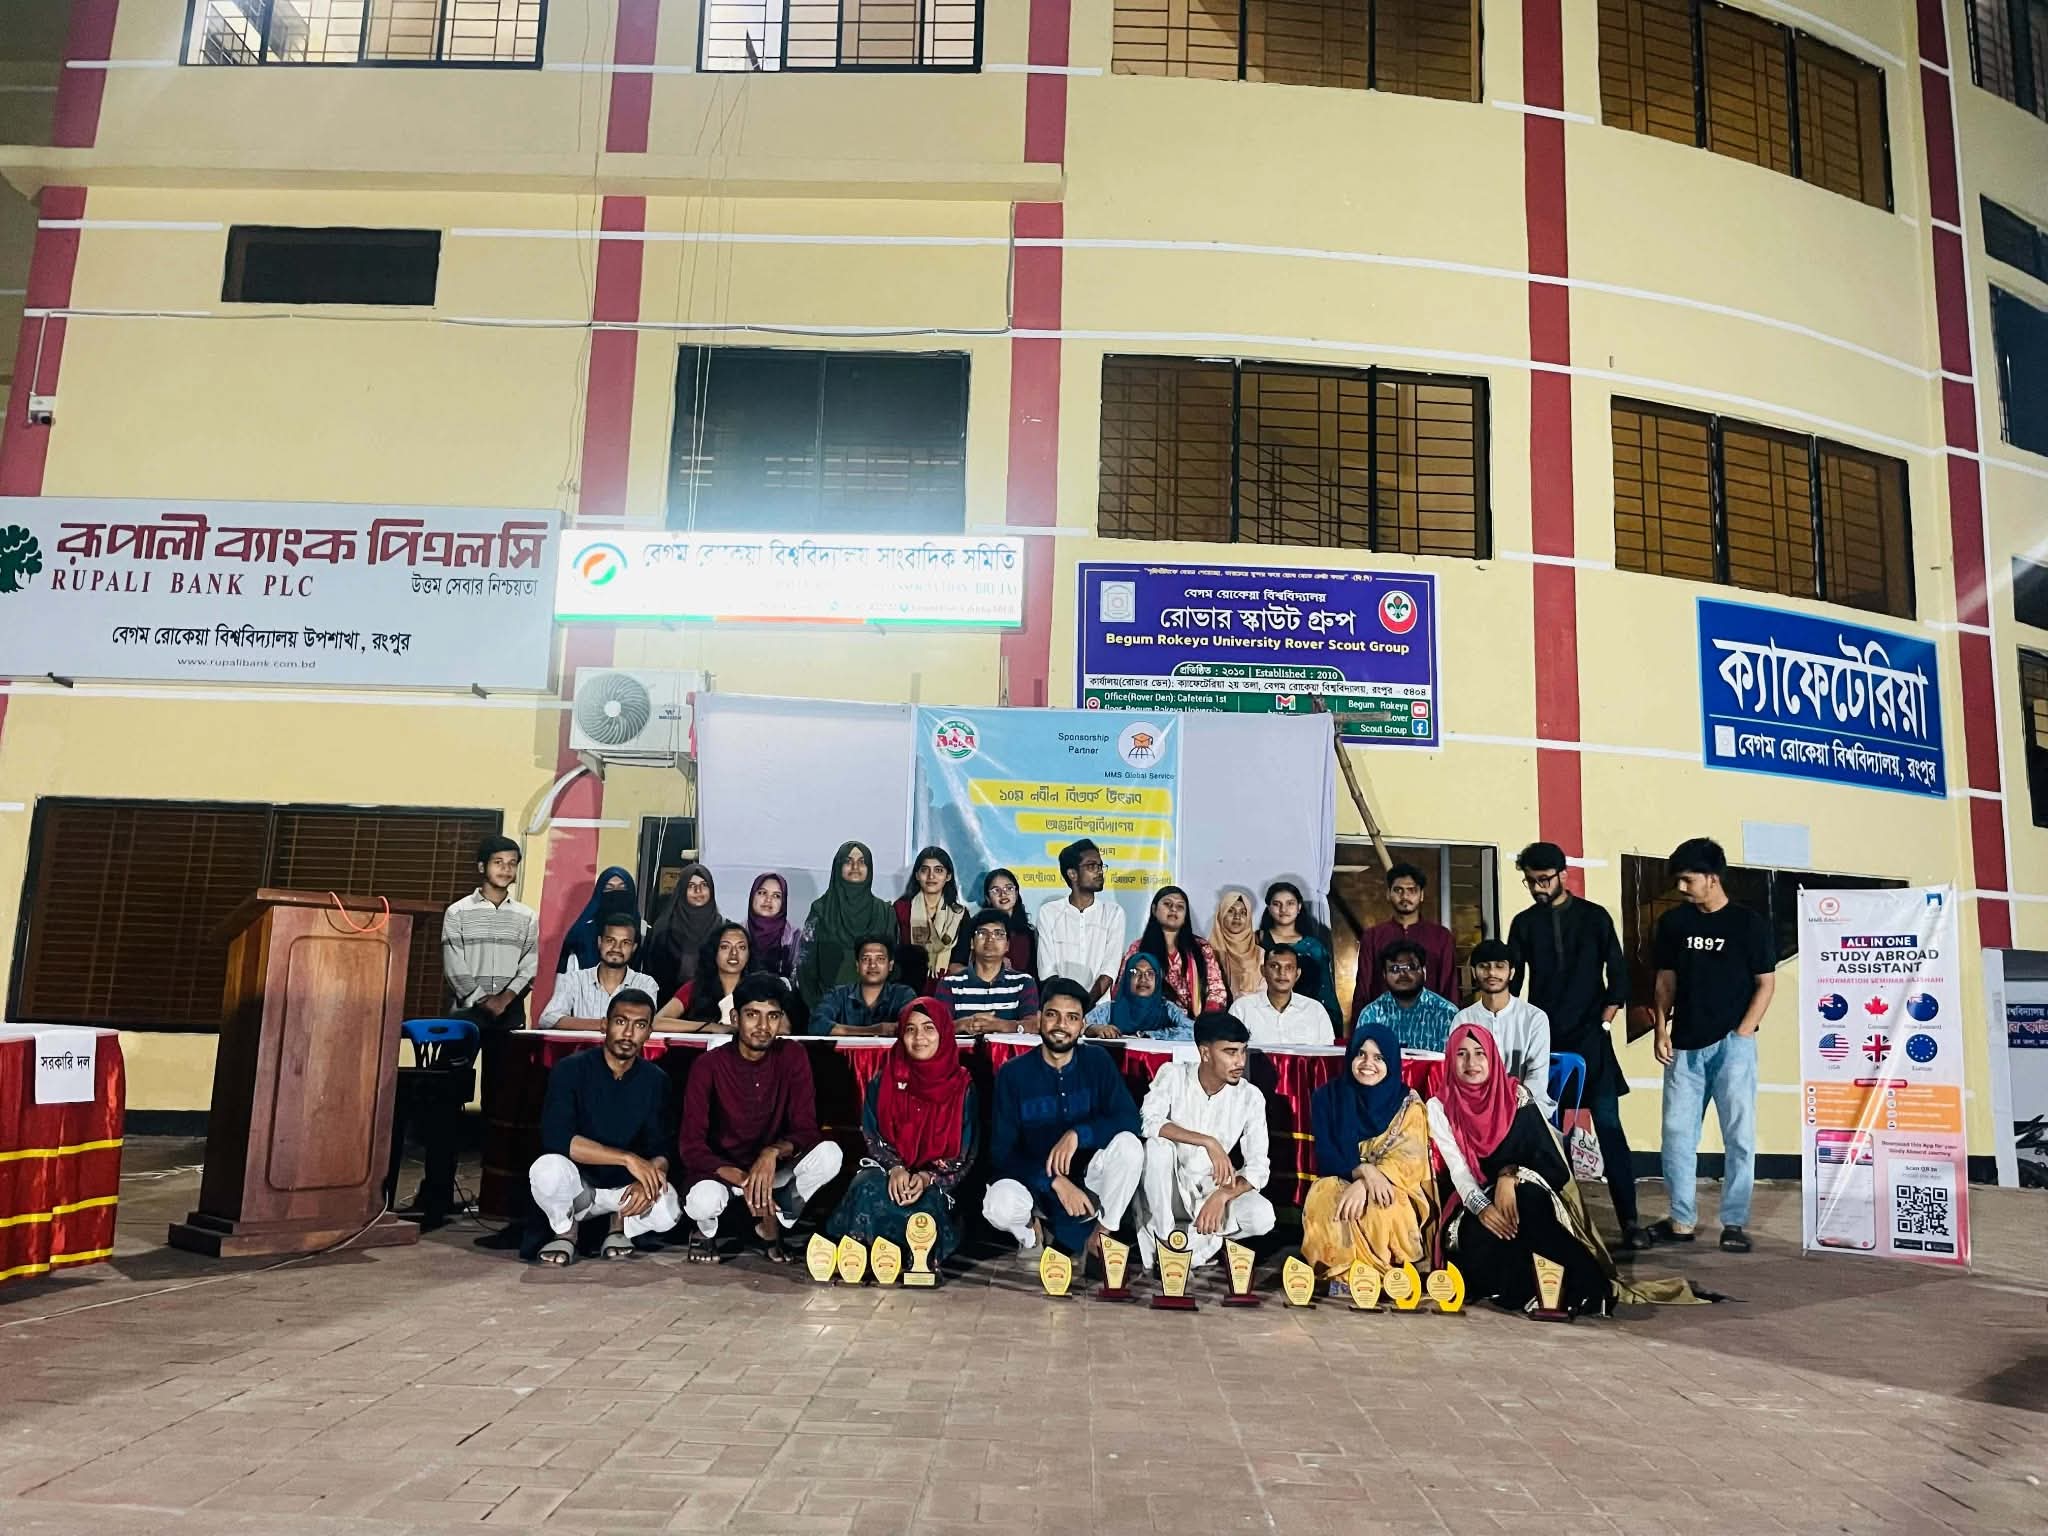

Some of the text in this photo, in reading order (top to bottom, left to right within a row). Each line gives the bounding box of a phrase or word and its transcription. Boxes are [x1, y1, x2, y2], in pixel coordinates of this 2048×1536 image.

[57, 513, 548, 569] রূপালী ব্যাংক পিএলসি
[962, 544, 1017, 570] সমিতি
[51, 569, 314, 597] RUPALI BANK PLC
[411, 571, 539, 597] উত্তম সেবার নিশ্চয়তা
[1184, 589, 1326, 603] বেগম রোকেয়া বিশ্ববিদ্যালয়
[1160, 603, 1357, 636] রোভার স্কাউট গ্রুপ
[113, 623, 411, 656] বেগম রোকেয়া বিশ্ববিদ্যালয় উপশাখা, রংপুর
[1105, 633, 1410, 655] Begum Rokeya University Rover Scout Group
[1255, 669, 1306, 679] Established
[1317, 671, 1338, 680] 2010
[1711, 633, 1929, 741] ক্যাফেটেরিয়া
[1177, 694, 1213, 704] Cafeteria
[1215, 694, 1227, 704] 1st
[1348, 700, 1409, 712] Begum Rokeya
[1058, 732, 1110, 743] Sponsorship
[1360, 724, 1408, 736] Scout Group
[1068, 745, 1099, 754] Partner
[1738, 732, 1937, 787] বেগম রোকেয়া বিশ্ববিদ্যালয়, রংপুর
[1104, 771, 1122, 779] MMS
[1124, 771, 1147, 779] Global
[1030, 785, 1059, 802] নবীন
[1066, 786, 1103, 802] বিতর্ক
[1686, 936, 1725, 951] 1897
[1846, 936, 1911, 948] ALL IN ONE
[1820, 949, 1939, 962] STUDY ABROAD
[1837, 962, 1922, 974] ASSISTANT
[40, 1051, 91, 1070] সরকারি দল
